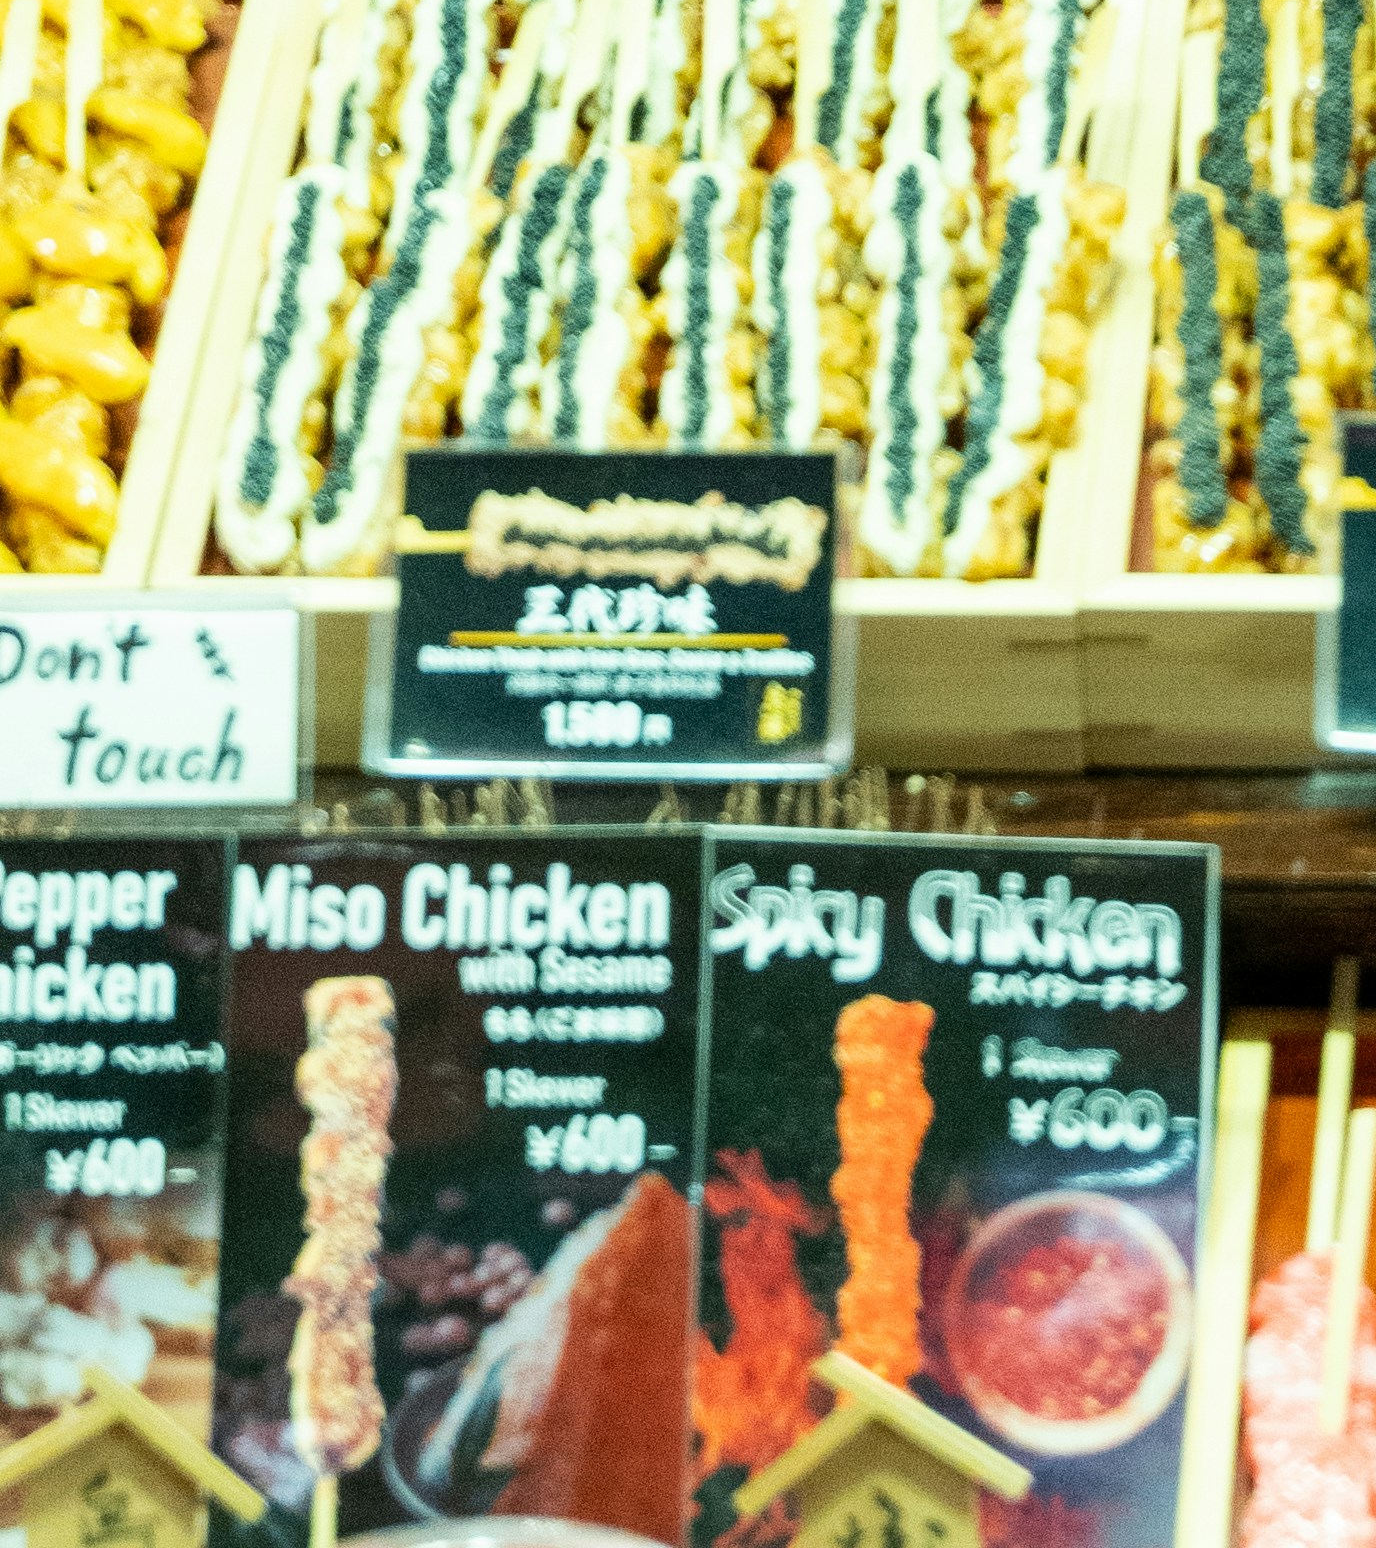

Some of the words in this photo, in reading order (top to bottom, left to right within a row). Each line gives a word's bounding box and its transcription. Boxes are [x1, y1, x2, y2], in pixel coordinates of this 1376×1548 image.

[59, 704, 246, 785] touch
[230, 863, 387, 954] Miso
[401, 863, 672, 952] Chicken
[709, 862, 886, 983] Spicy
[908, 868, 1183, 979] Chicken
[459, 946, 536, 994] with
[538, 948, 673, 994] Sesame
[25, 1093, 128, 1132] Skewer
[504, 1068, 607, 1108] Skewer
